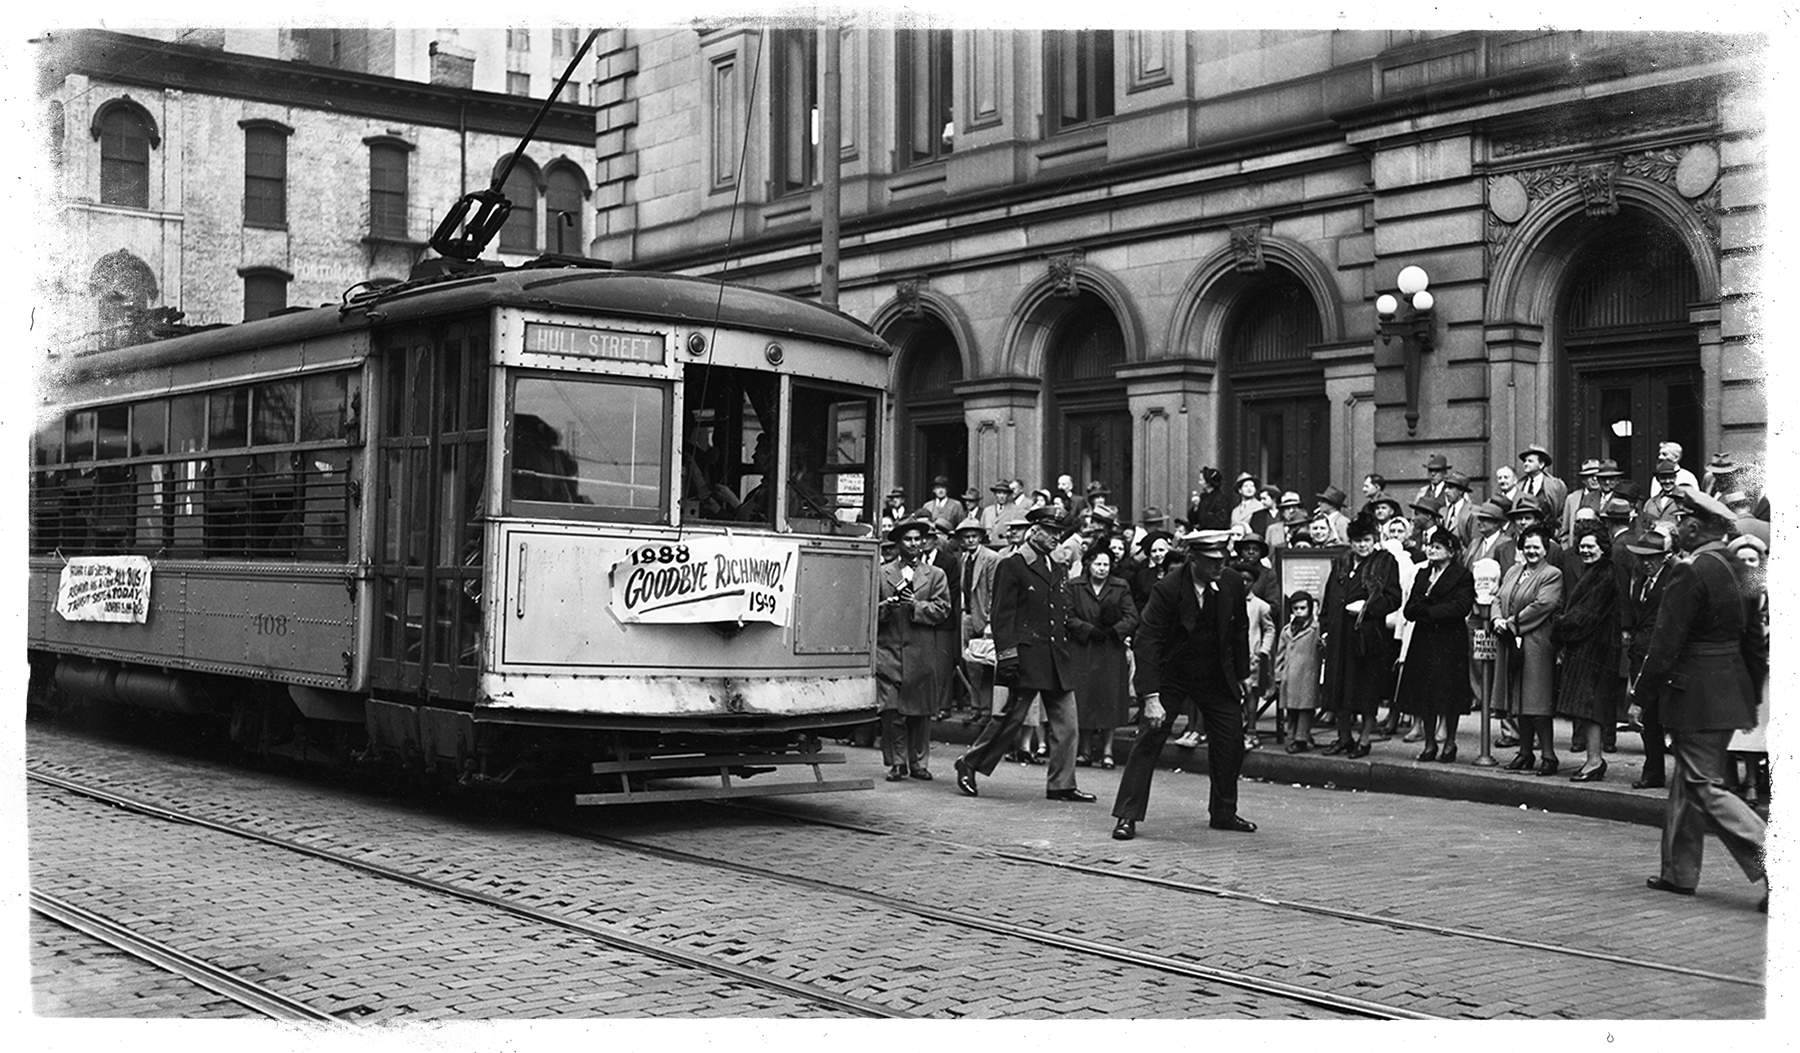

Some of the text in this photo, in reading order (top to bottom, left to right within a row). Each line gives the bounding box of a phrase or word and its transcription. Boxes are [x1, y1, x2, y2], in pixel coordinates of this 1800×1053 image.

[537, 329, 652, 361] HULL STREET
[624, 561, 708, 610] GOODBYE
[252, 613, 287, 636] 408
